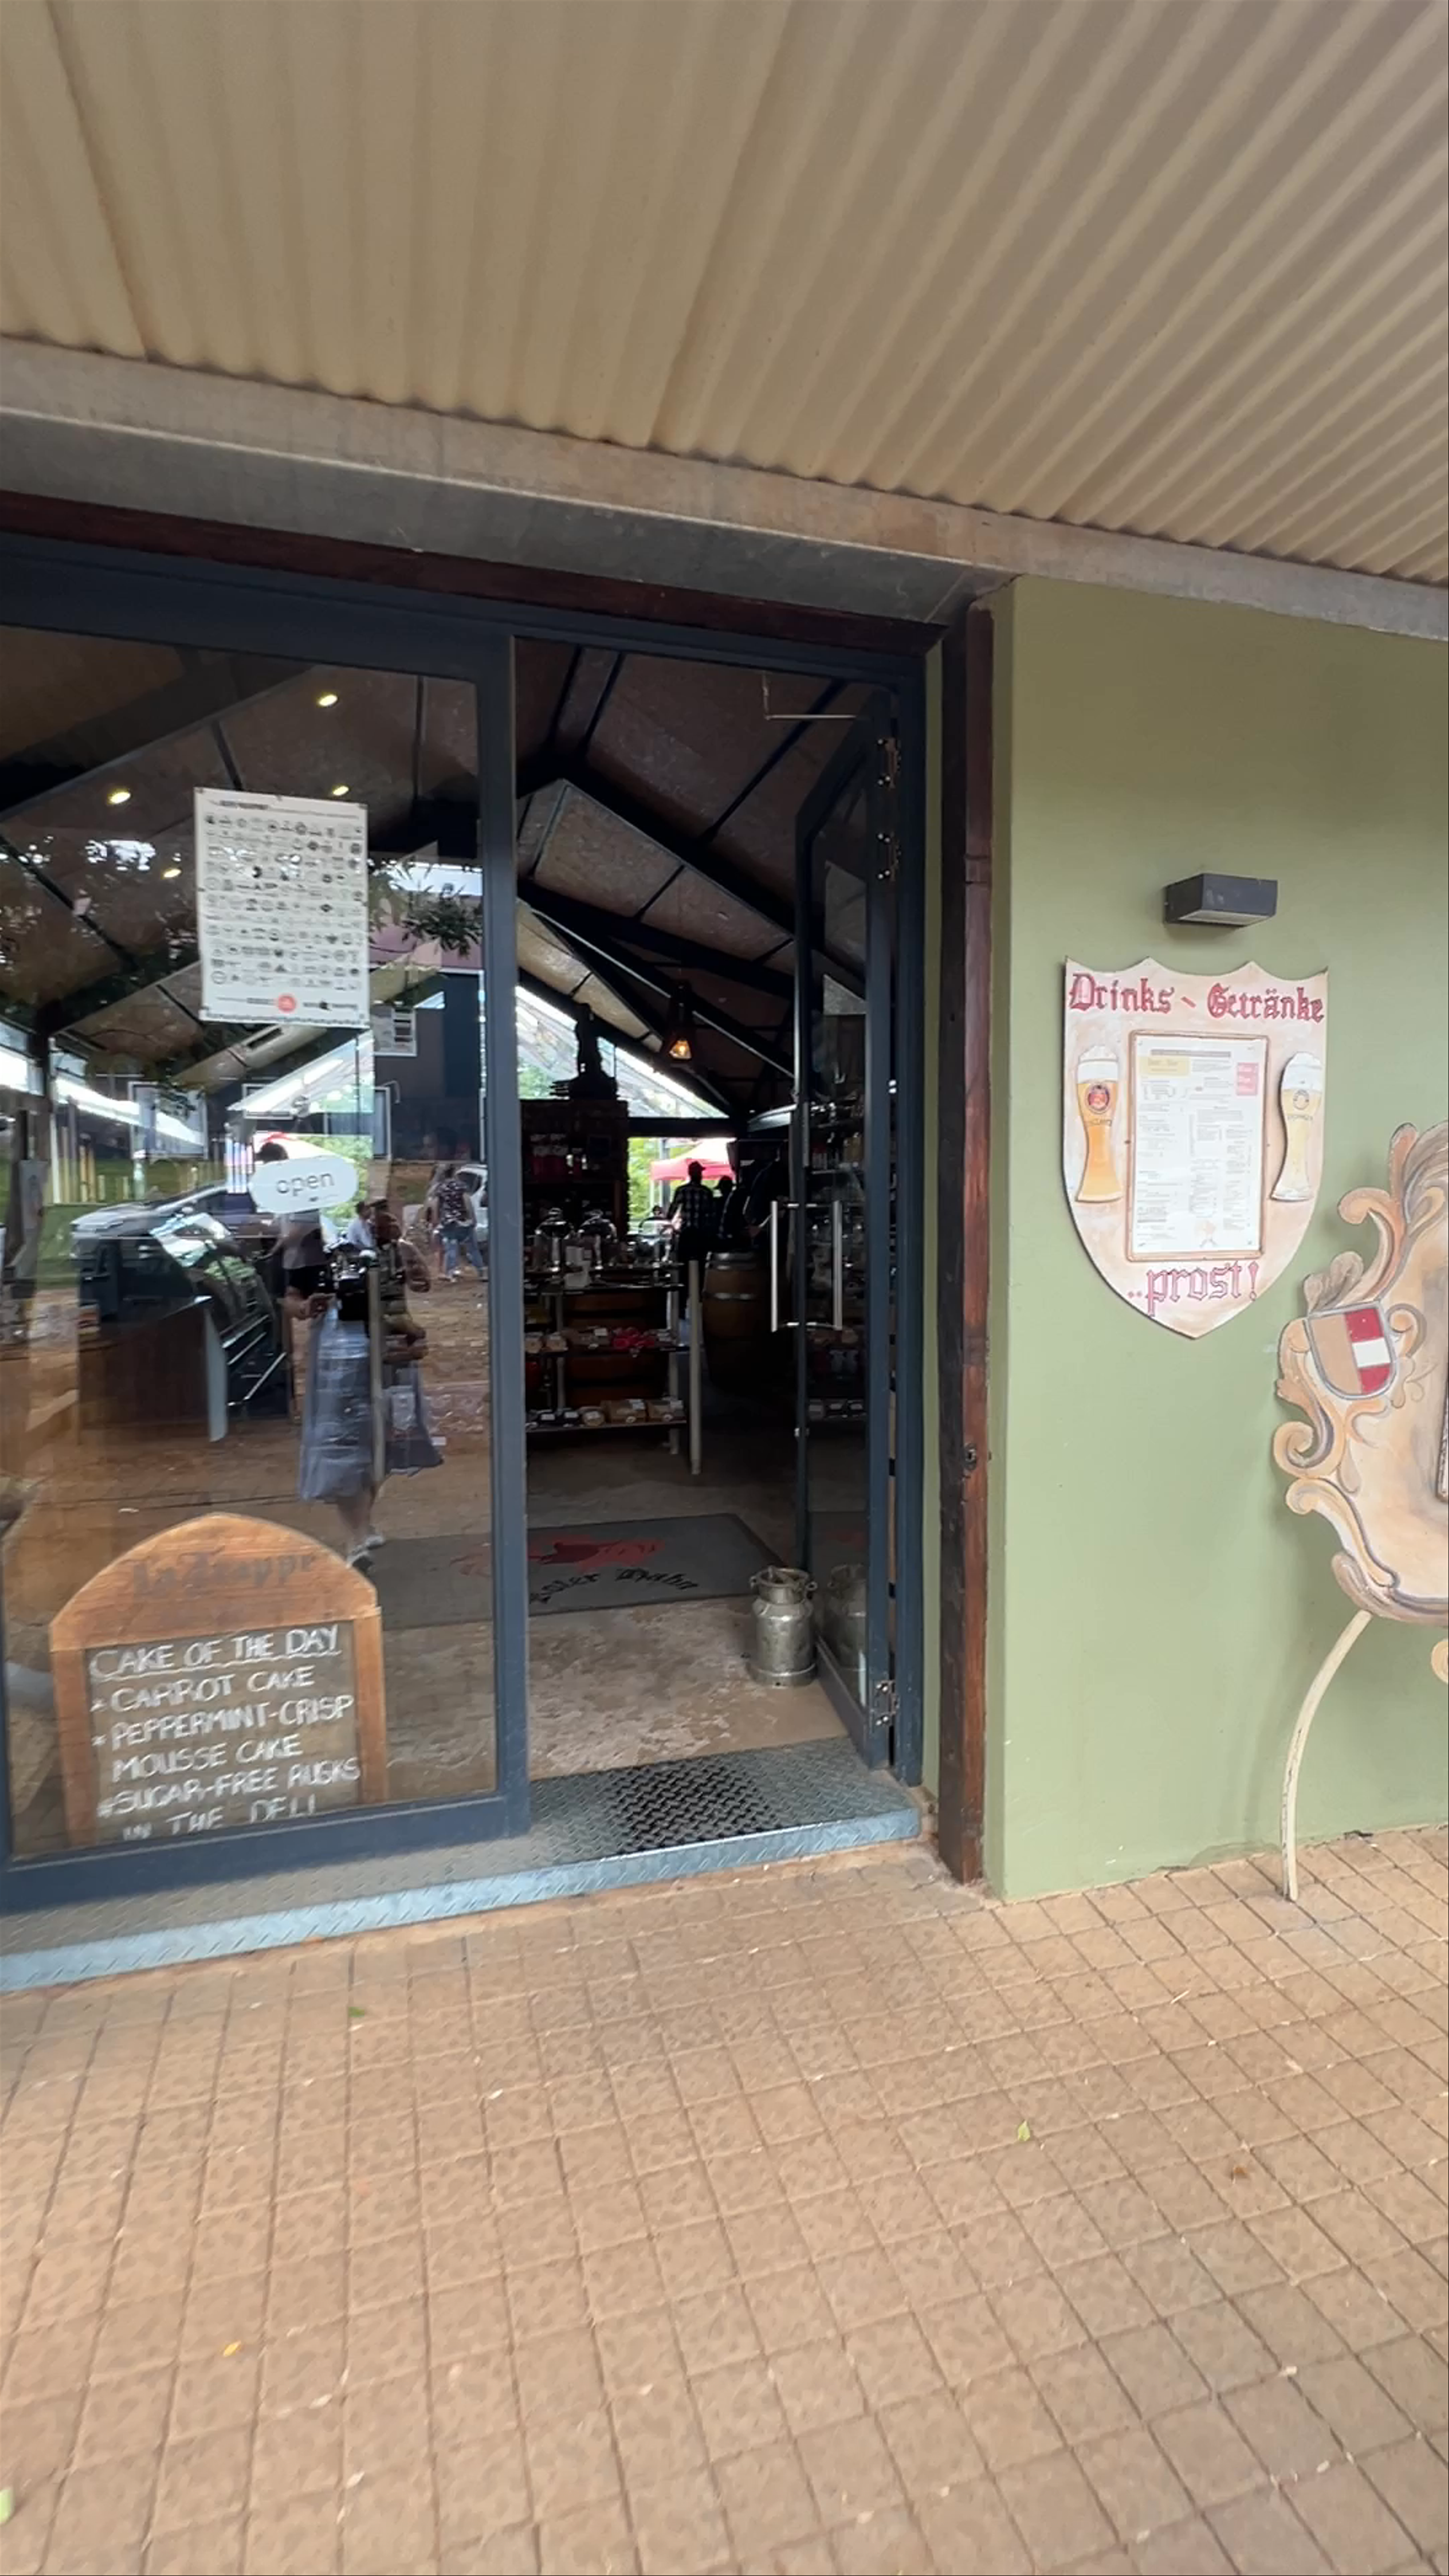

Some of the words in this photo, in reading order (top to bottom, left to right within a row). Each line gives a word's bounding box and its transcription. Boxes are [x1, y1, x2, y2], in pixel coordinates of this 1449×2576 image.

[1069, 973, 1175, 1014] Drinks
[1207, 983, 1324, 1023] Getränke
[277, 1173, 335, 1197] open
[89, 1644, 175, 1678] CAKE
[184, 1639, 223, 1666] OF
[231, 1633, 274, 1659] THE
[286, 1624, 338, 1654] DAY
[111, 1673, 236, 1712] CARROT
[246, 1664, 315, 1692] CAKE
[112, 1695, 355, 1752] PEPPERMINT-CRISP
[112, 1742, 228, 1783] MOUSSE
[235, 1733, 303, 1764] CAKE
[112, 1767, 279, 1814] SUGAR-FREE
[288, 1756, 361, 1790] RUSKS
[165, 1806, 224, 1835] THE
[249, 1793, 316, 1824] DELI
